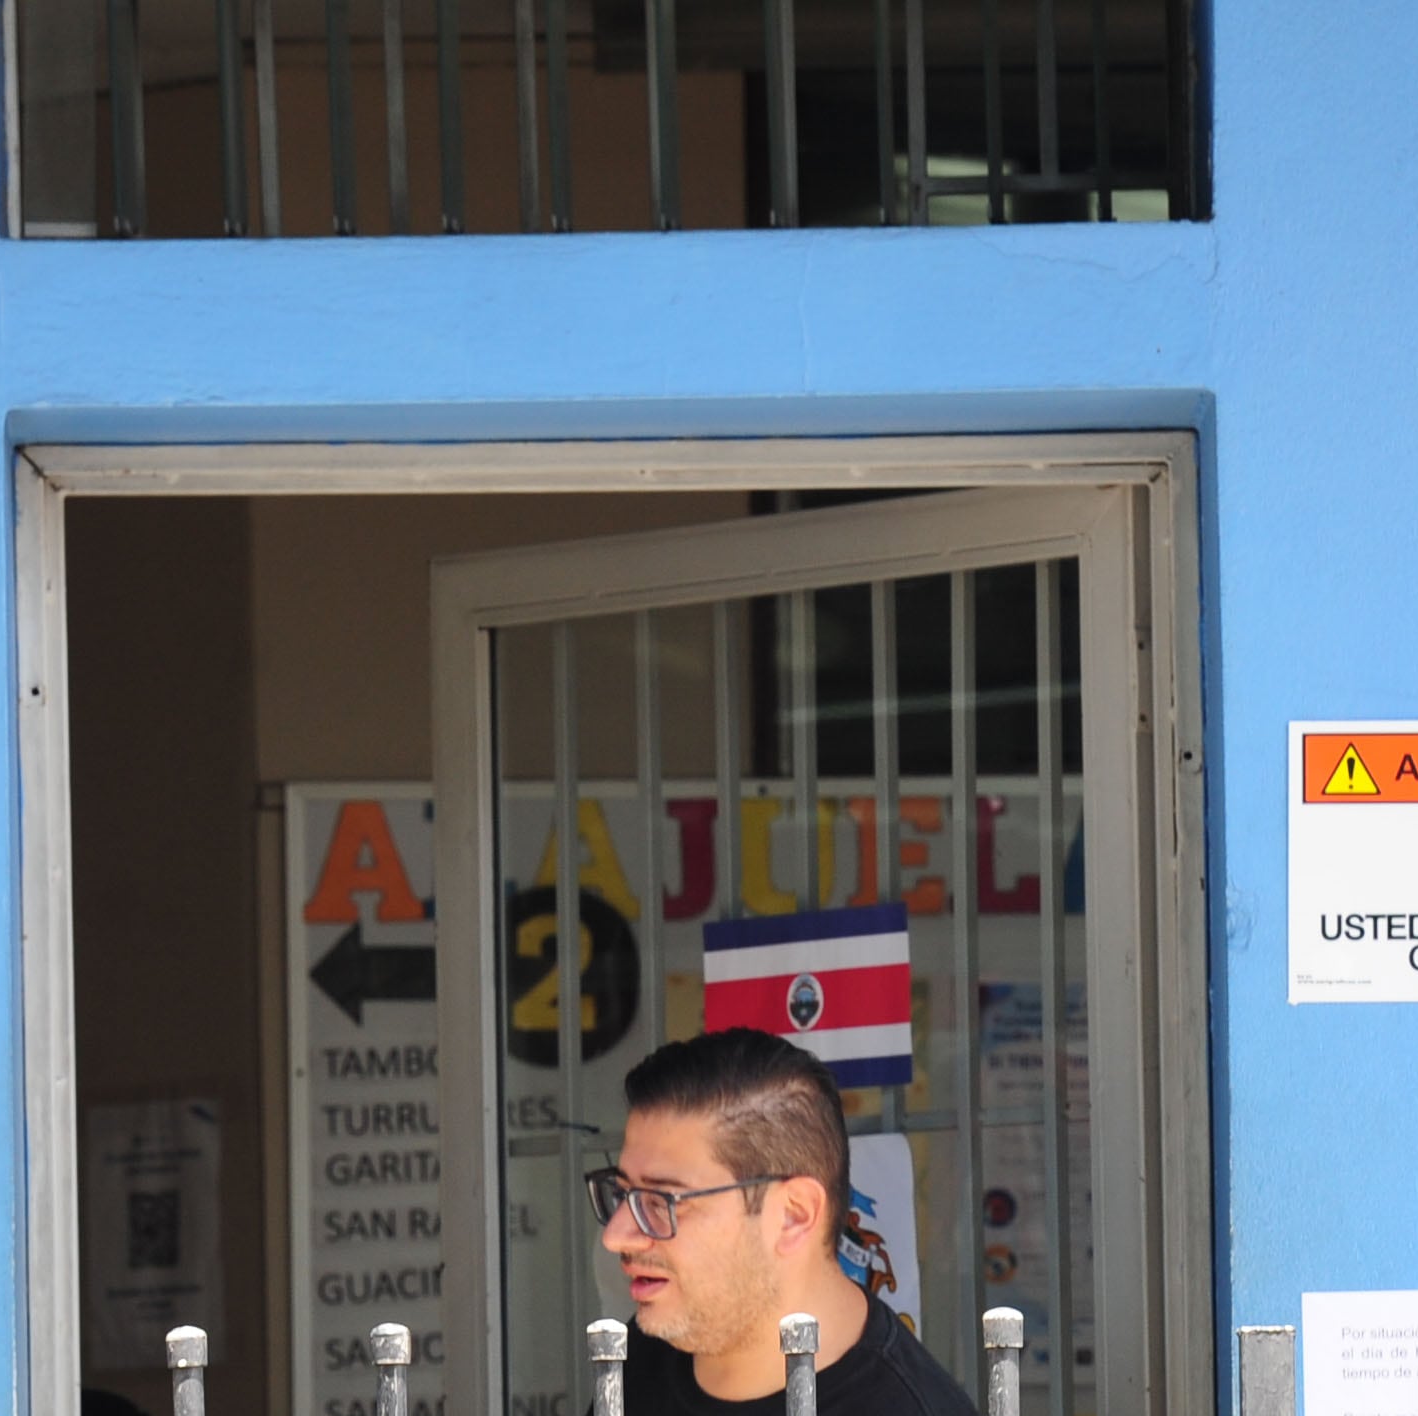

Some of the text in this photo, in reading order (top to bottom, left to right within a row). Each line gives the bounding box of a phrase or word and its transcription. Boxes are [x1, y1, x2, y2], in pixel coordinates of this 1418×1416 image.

[511, 913, 596, 1031] 2
[323, 1208, 397, 1243] SAN
[1341, 1326, 1366, 1341] Por
[1341, 1346, 1354, 1360] el
[1390, 1344, 1409, 1360] de
[1342, 1366, 1390, 1382] tiempo
[1394, 1365, 1412, 1379] de
